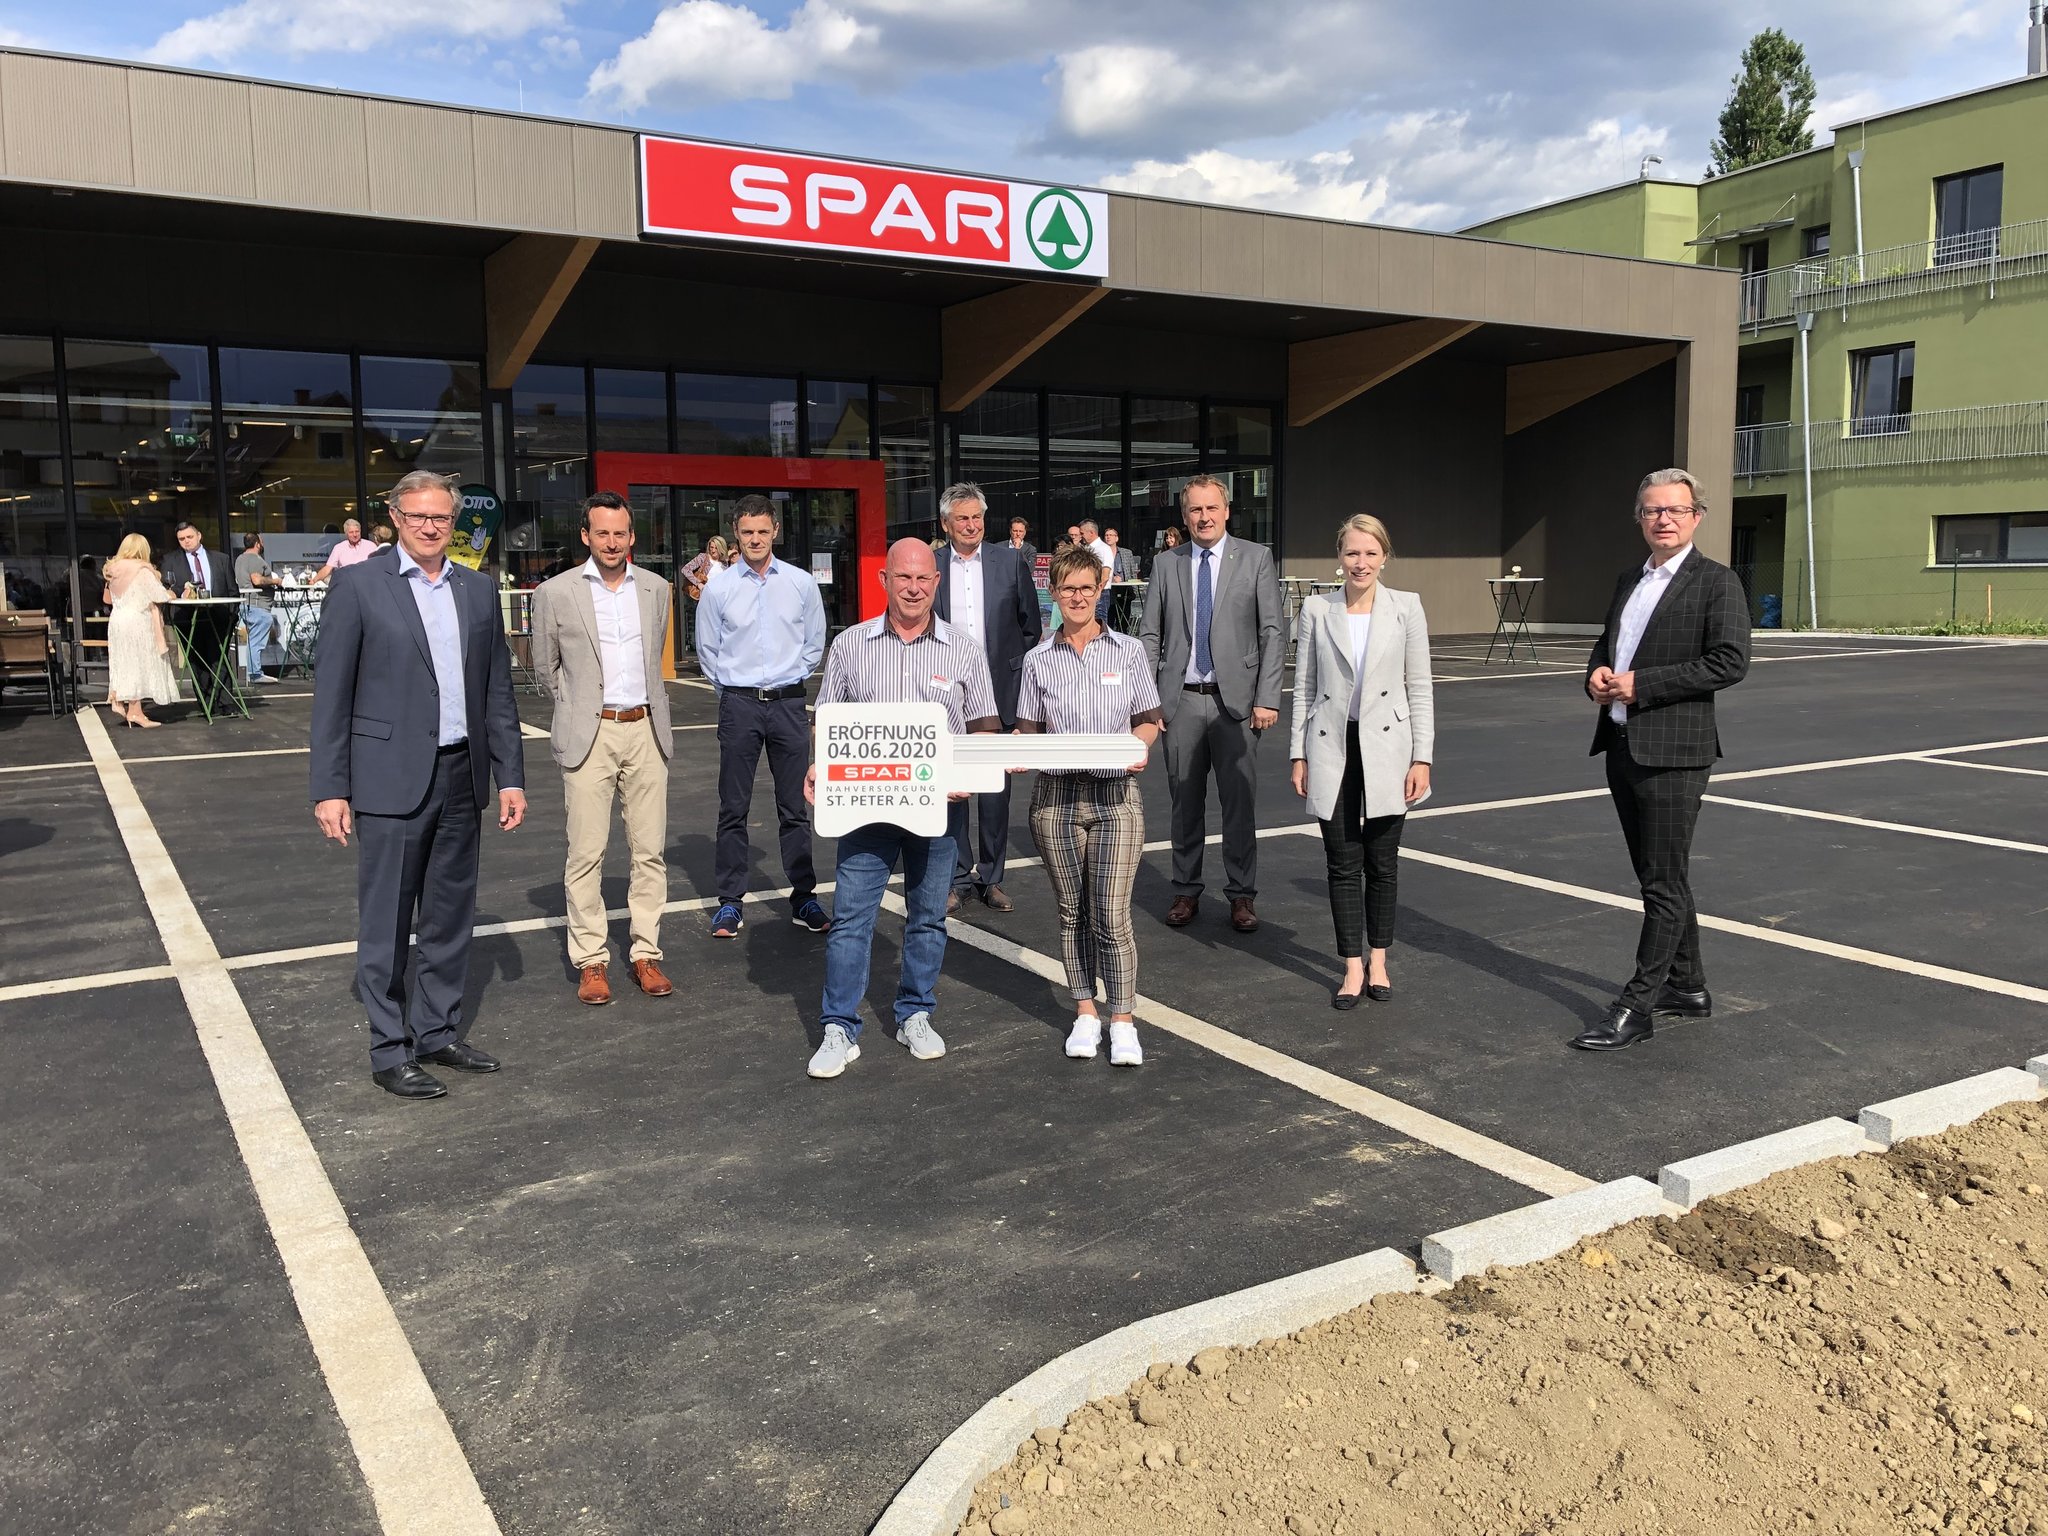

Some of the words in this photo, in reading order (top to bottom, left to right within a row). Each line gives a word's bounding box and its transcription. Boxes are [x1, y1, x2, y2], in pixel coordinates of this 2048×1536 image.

[730, 164, 1004, 249] SPAR
[462, 495, 496, 510] OTTO
[828, 721, 937, 740] ERÖFFNUNG
[827, 742, 937, 759] 04.06.2020
[844, 766, 910, 779] SPAR
[826, 785, 936, 793] NAHVERSORGUNG
[826, 795, 846, 806] ST.
[850, 795, 895, 806] PETER
[898, 795, 914, 806] A.
[919, 794, 935, 806] O.
